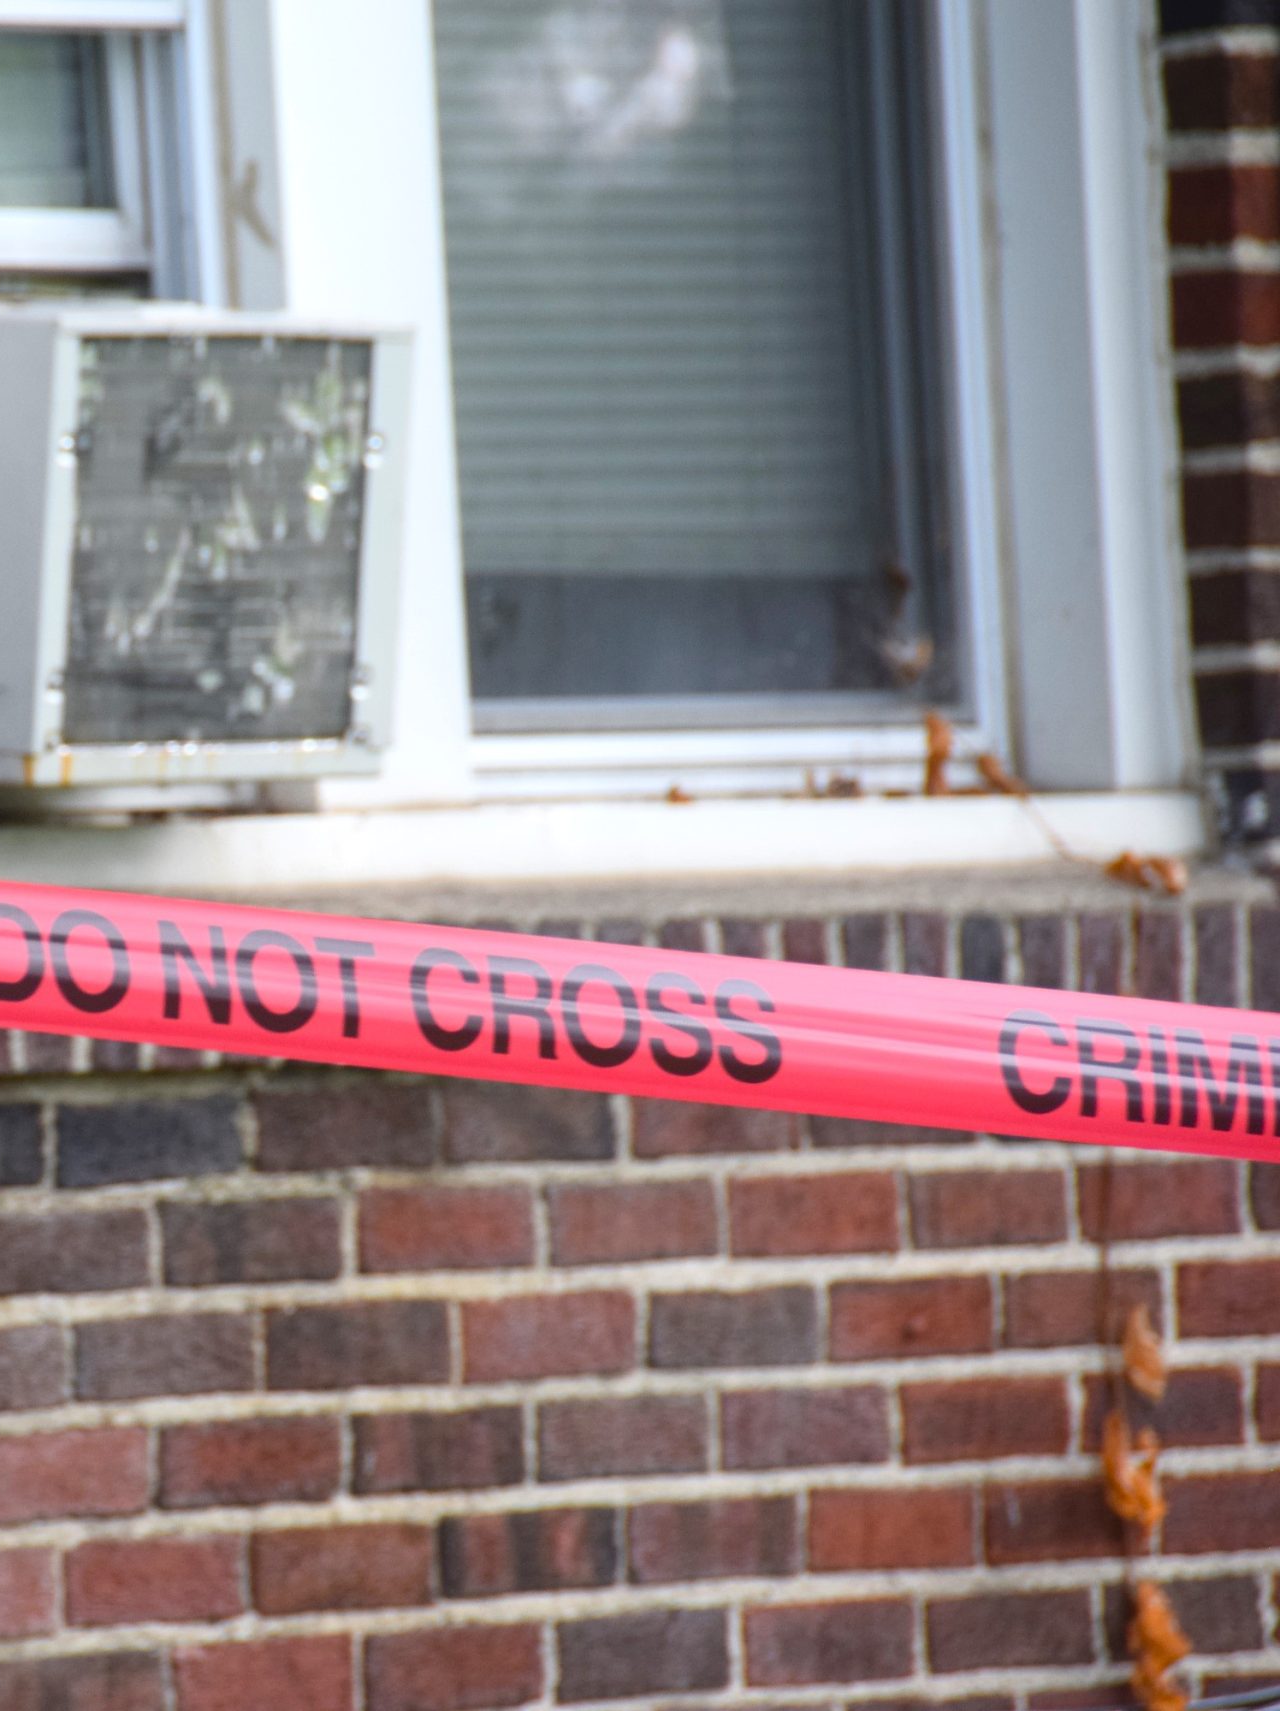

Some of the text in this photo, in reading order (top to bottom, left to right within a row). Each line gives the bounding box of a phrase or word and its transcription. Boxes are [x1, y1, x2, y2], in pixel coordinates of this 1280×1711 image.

[157, 920, 375, 1039] NOT
[409, 947, 783, 1084] CROSS
[998, 1010, 1280, 1138] CRIM
